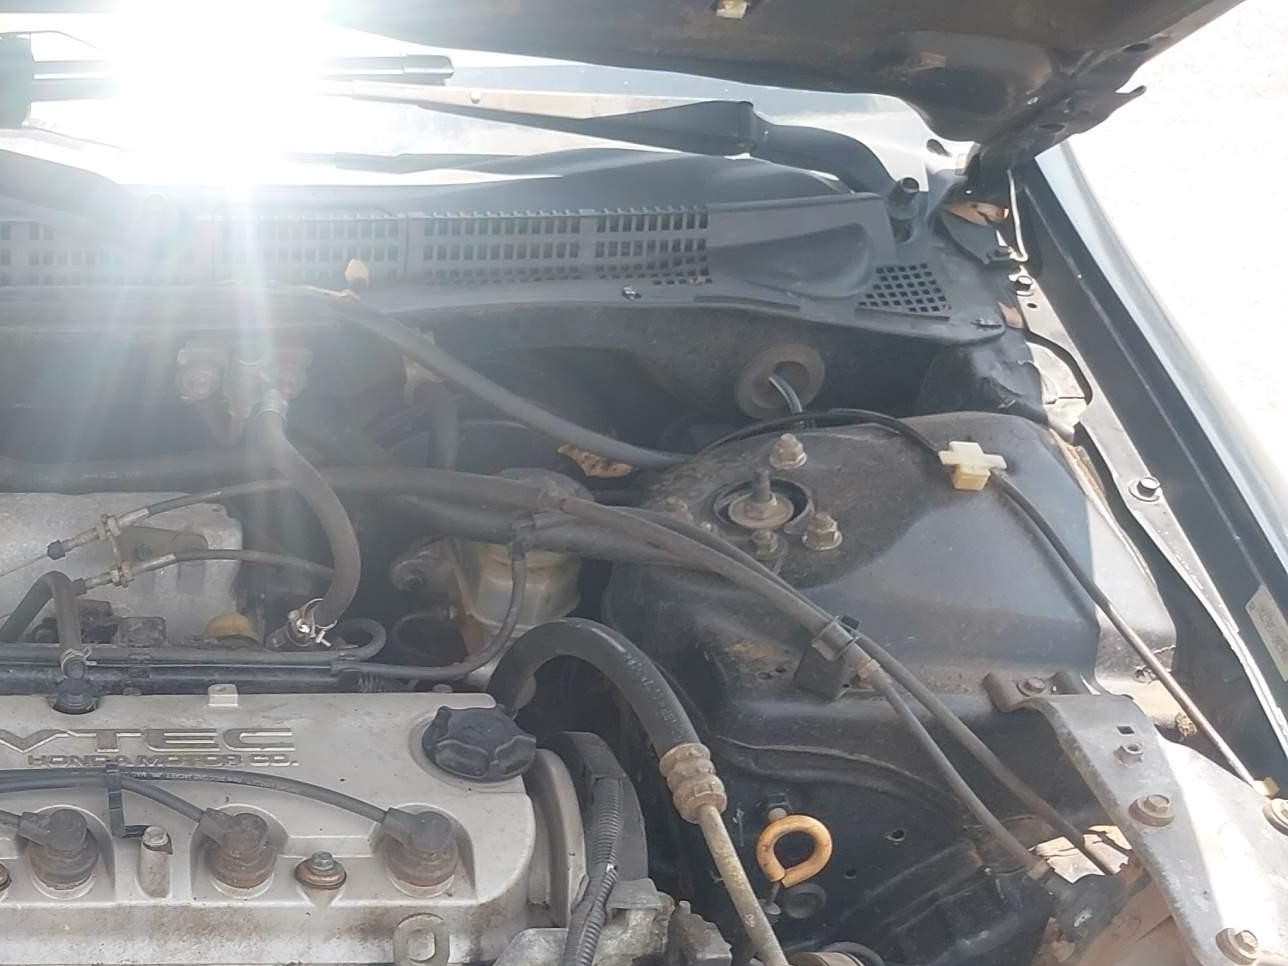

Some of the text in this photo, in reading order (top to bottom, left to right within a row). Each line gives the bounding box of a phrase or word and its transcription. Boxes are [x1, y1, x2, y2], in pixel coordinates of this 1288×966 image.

[27, 754, 298, 766] HONDA MOTOR CO.
